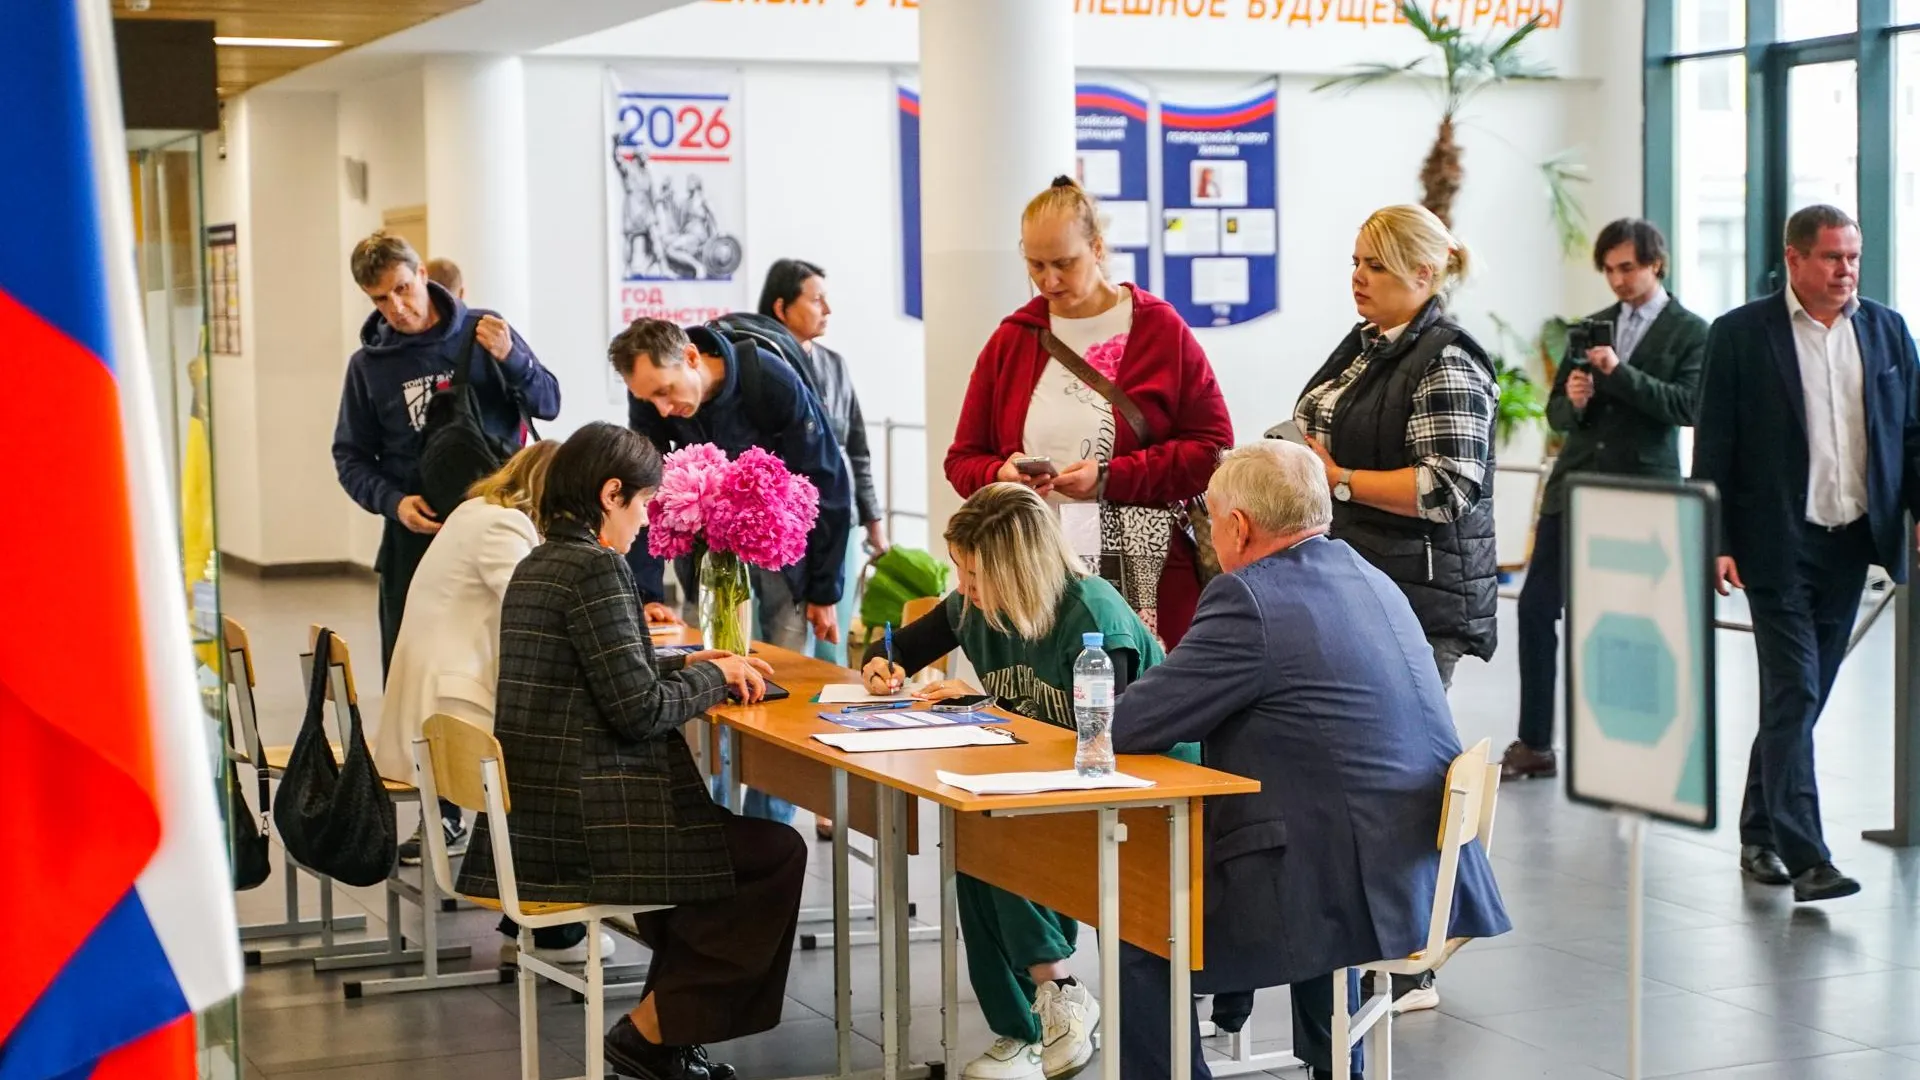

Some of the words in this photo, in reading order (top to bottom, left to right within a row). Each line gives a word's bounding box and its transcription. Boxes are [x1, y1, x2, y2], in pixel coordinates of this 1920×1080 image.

[1432, 0, 1563, 28] СТРАНЫ
[619, 105, 730, 149] 2026
[621, 287, 663, 305] ГОД
